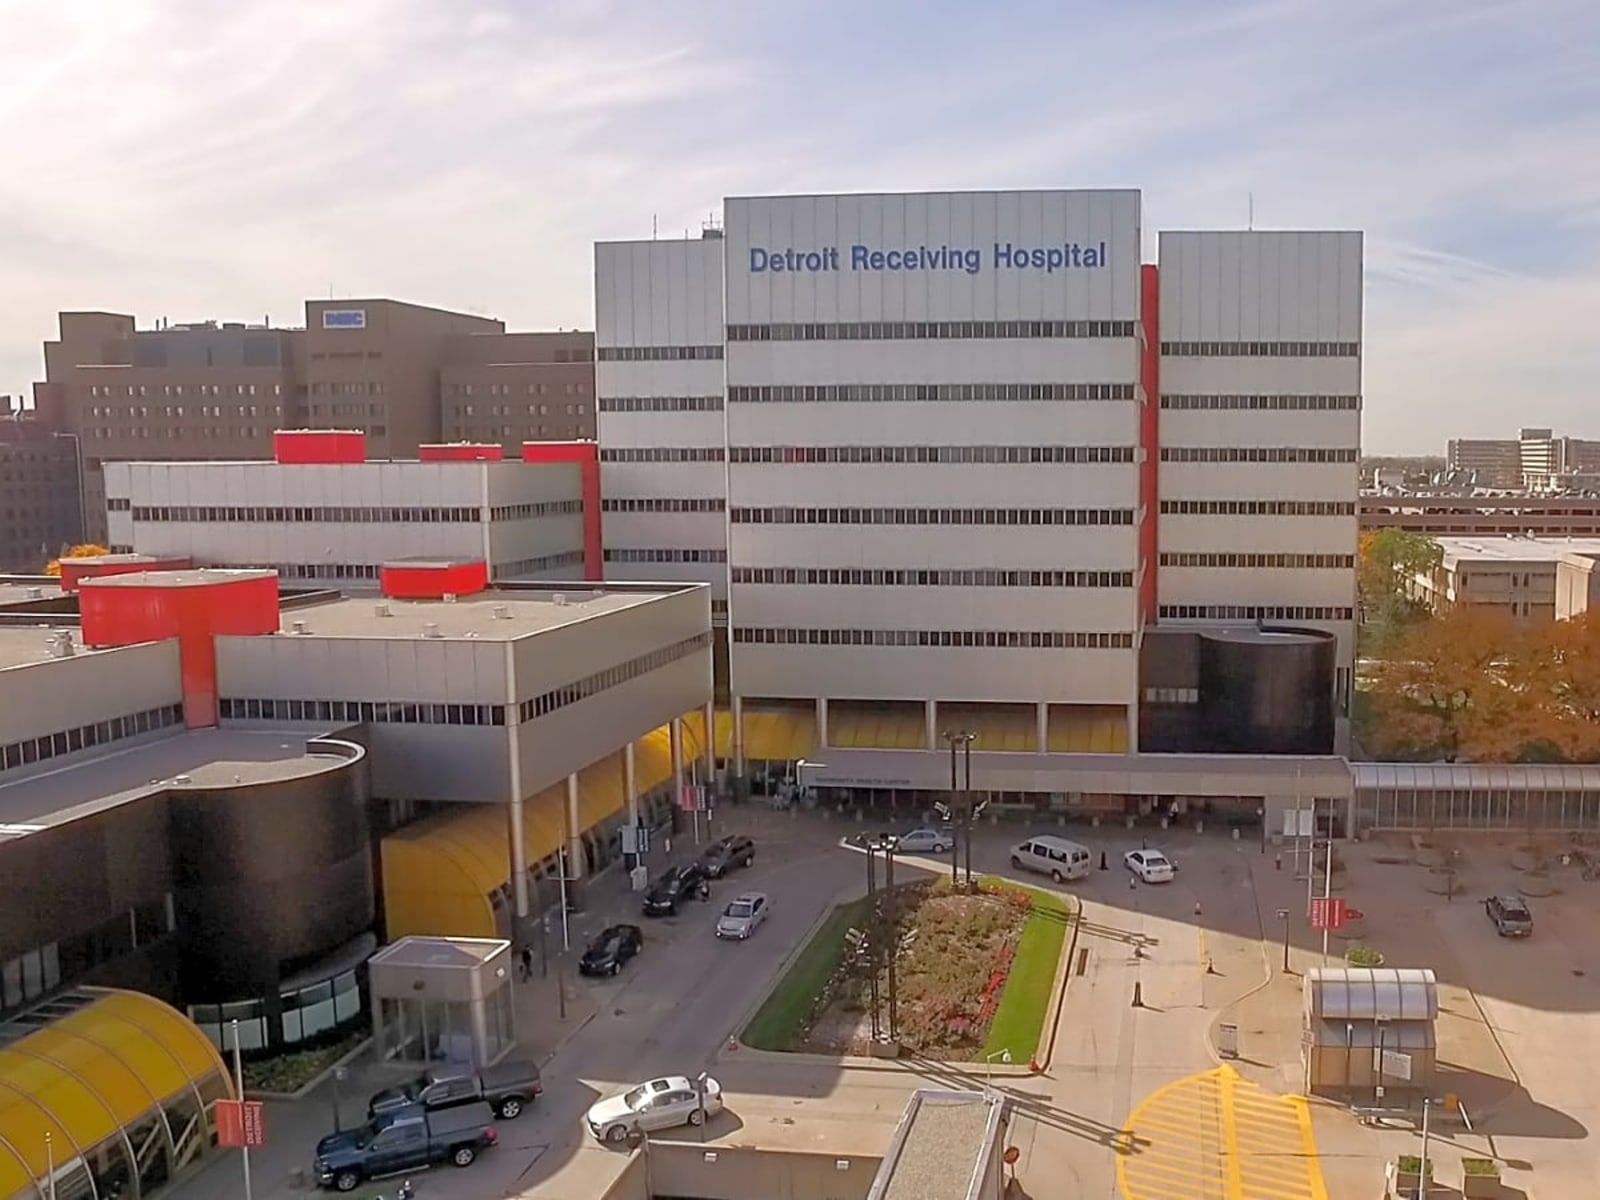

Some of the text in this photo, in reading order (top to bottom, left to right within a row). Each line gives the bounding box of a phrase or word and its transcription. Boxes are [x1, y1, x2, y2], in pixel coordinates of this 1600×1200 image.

[750, 242, 1105, 275] Detroit Receiving Hospital
